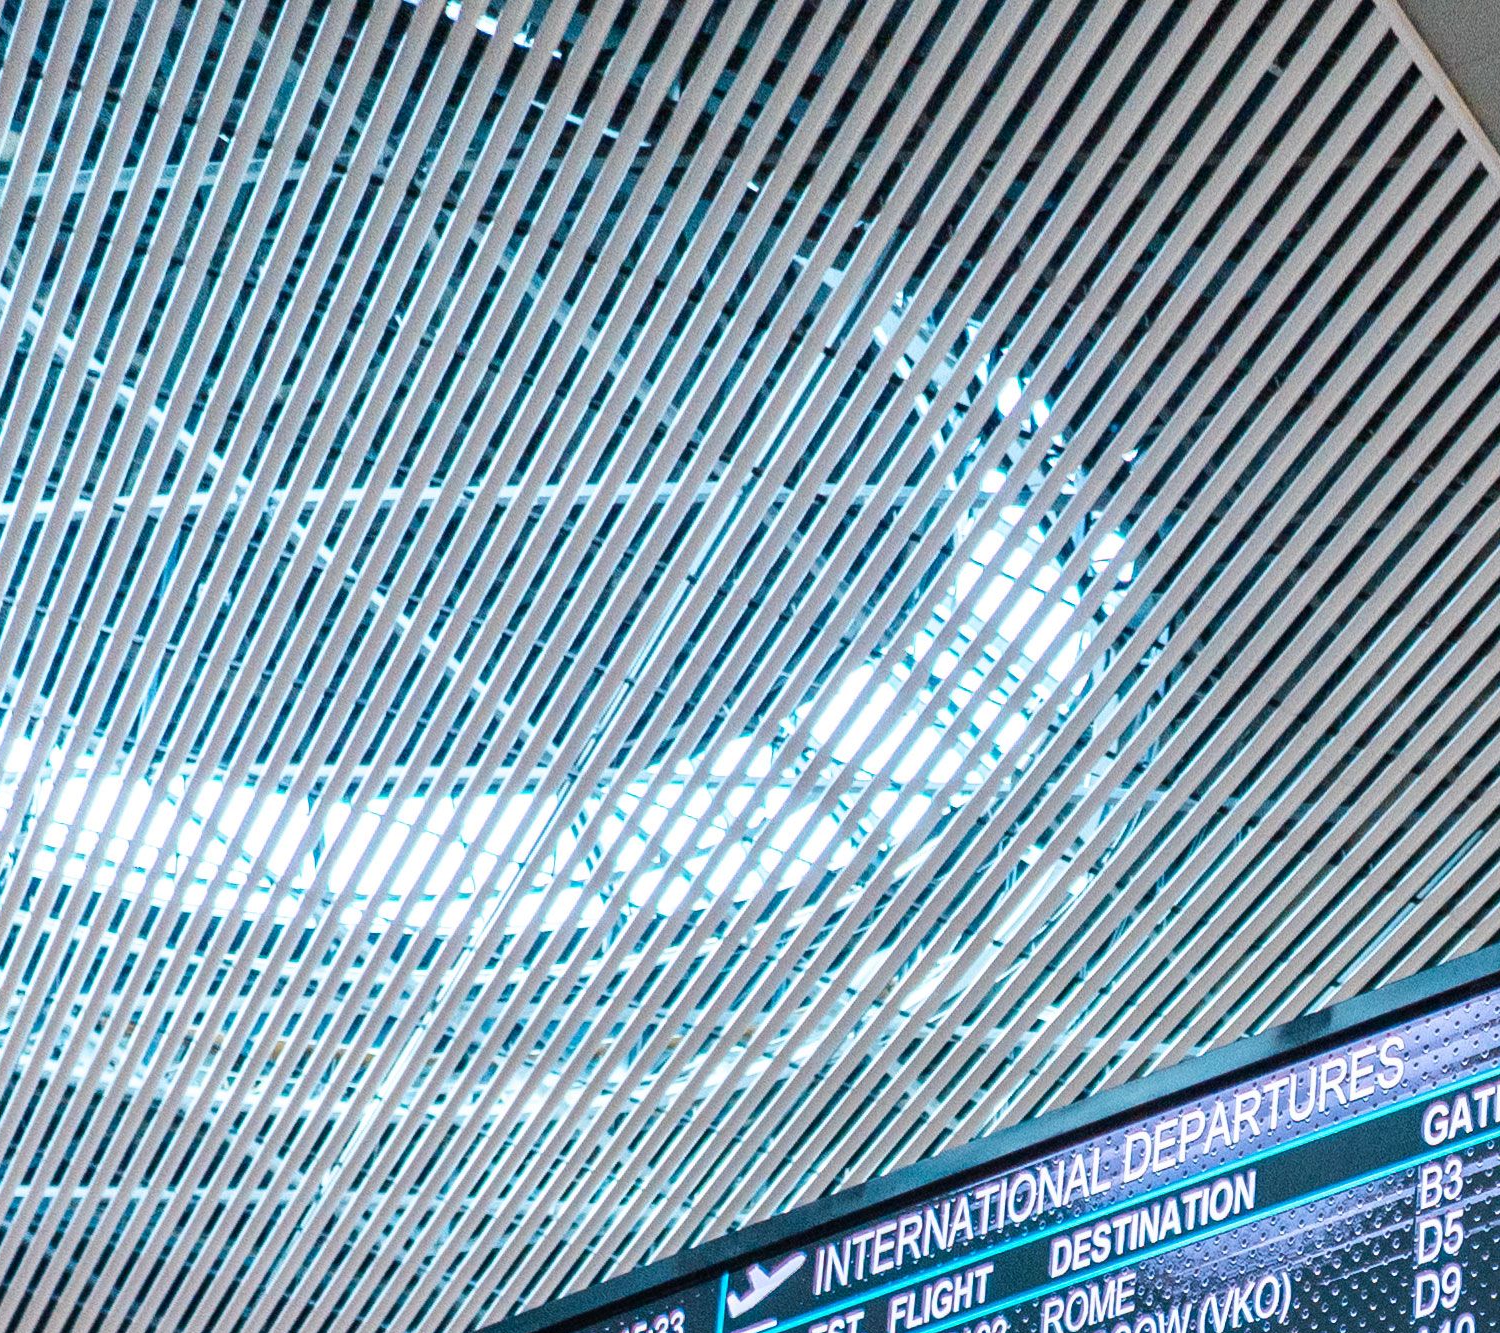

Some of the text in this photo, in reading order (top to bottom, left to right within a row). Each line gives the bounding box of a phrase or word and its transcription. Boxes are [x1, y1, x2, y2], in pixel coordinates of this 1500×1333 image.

[812, 1028, 1411, 1297] INTERNATIONAL DEPARTURES
[1047, 1168, 1257, 1279] DESTINATION
[1412, 1205, 1466, 1266] D5
